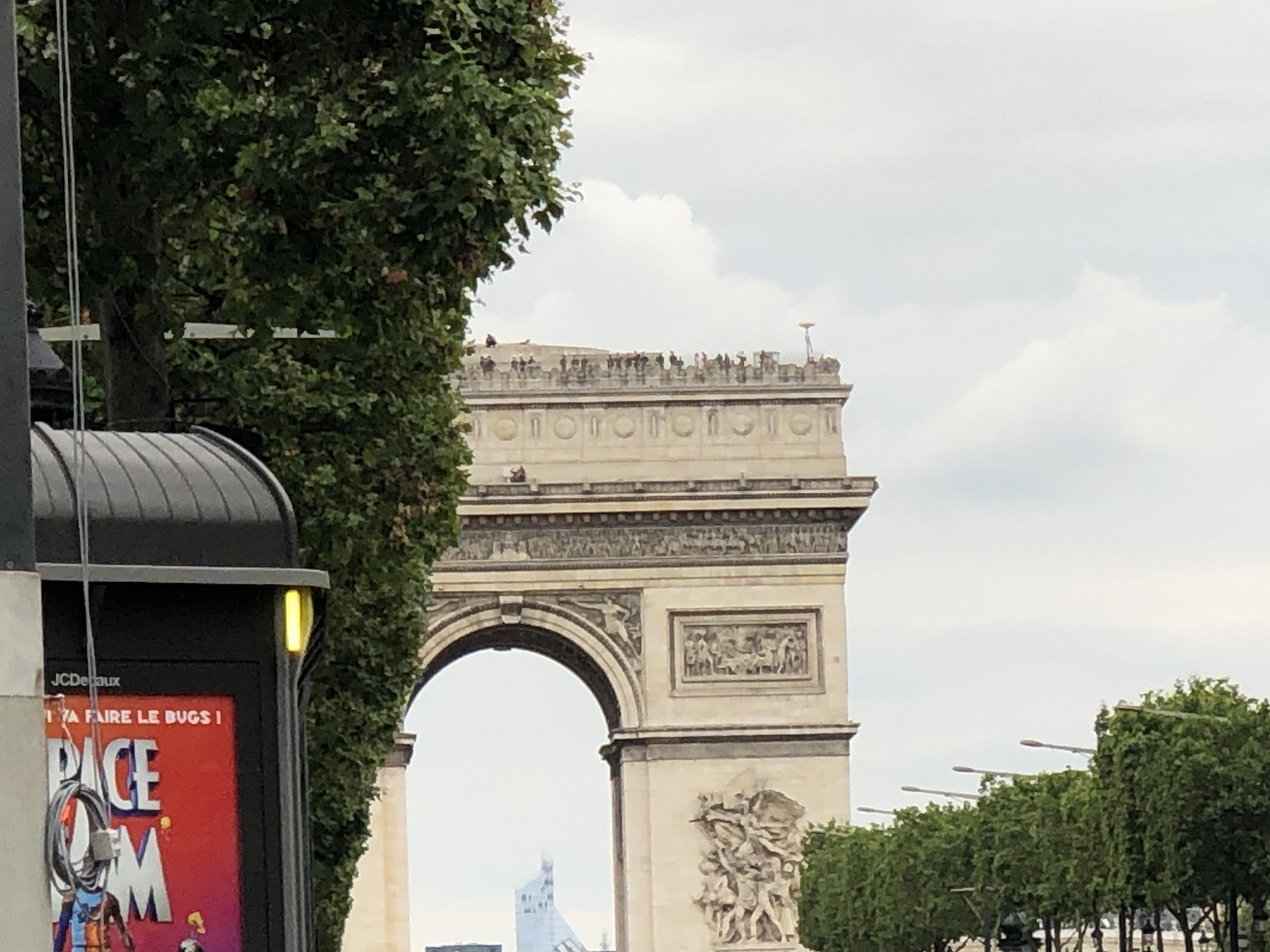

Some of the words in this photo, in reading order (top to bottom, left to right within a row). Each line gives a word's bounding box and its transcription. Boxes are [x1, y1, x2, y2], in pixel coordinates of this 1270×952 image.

[85, 709, 132, 725] FAIRE
[137, 709, 160, 724] LE
[165, 709, 211, 725] BUGS
